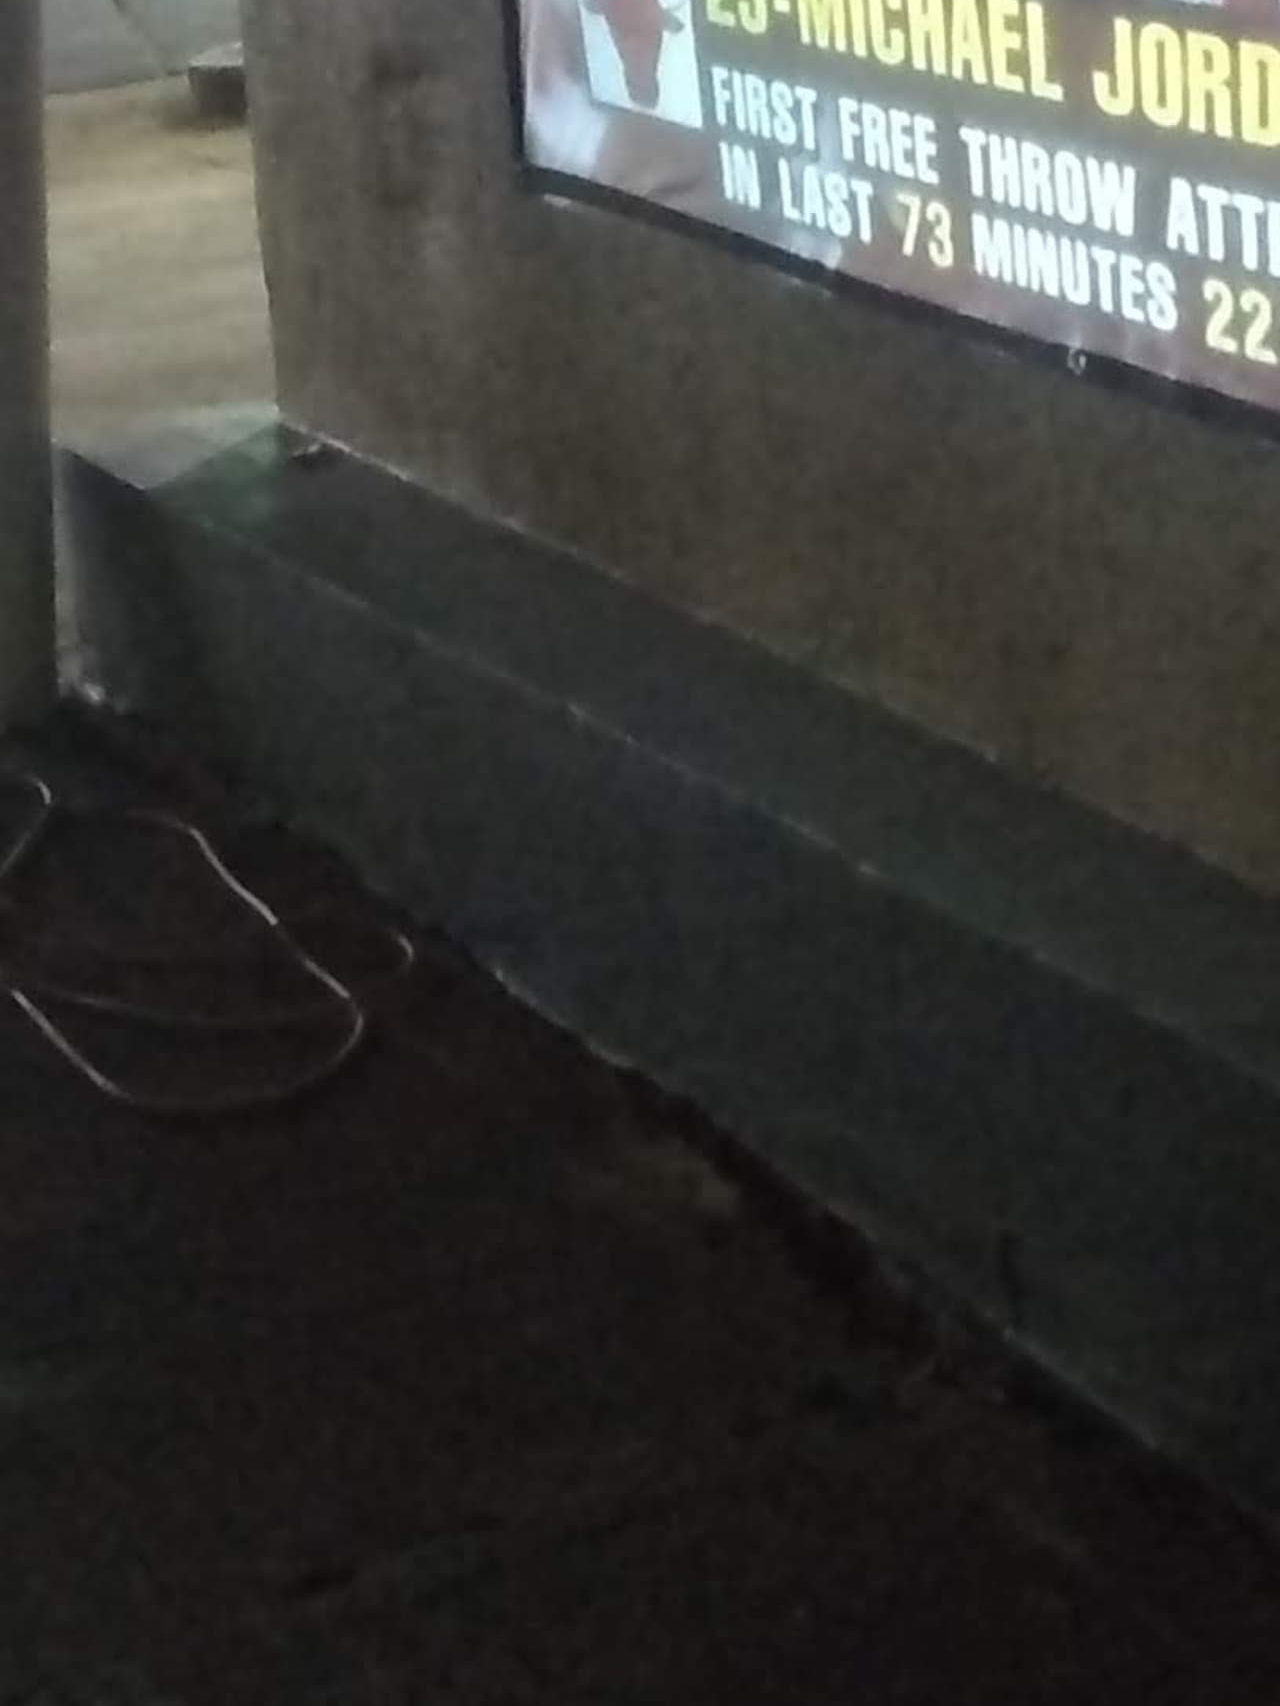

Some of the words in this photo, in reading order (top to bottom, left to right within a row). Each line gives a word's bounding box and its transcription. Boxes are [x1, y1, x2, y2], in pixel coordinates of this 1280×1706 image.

[711, 66, 819, 152] FIRST
[838, 97, 940, 186] FREE
[959, 125, 1136, 237] THROW
[719, 140, 761, 212] IN
[779, 166, 876, 243] LAST
[896, 194, 955, 270] 73
[972, 213, 1178, 333] MINUTES
[1203, 278, 1278, 366] 22
